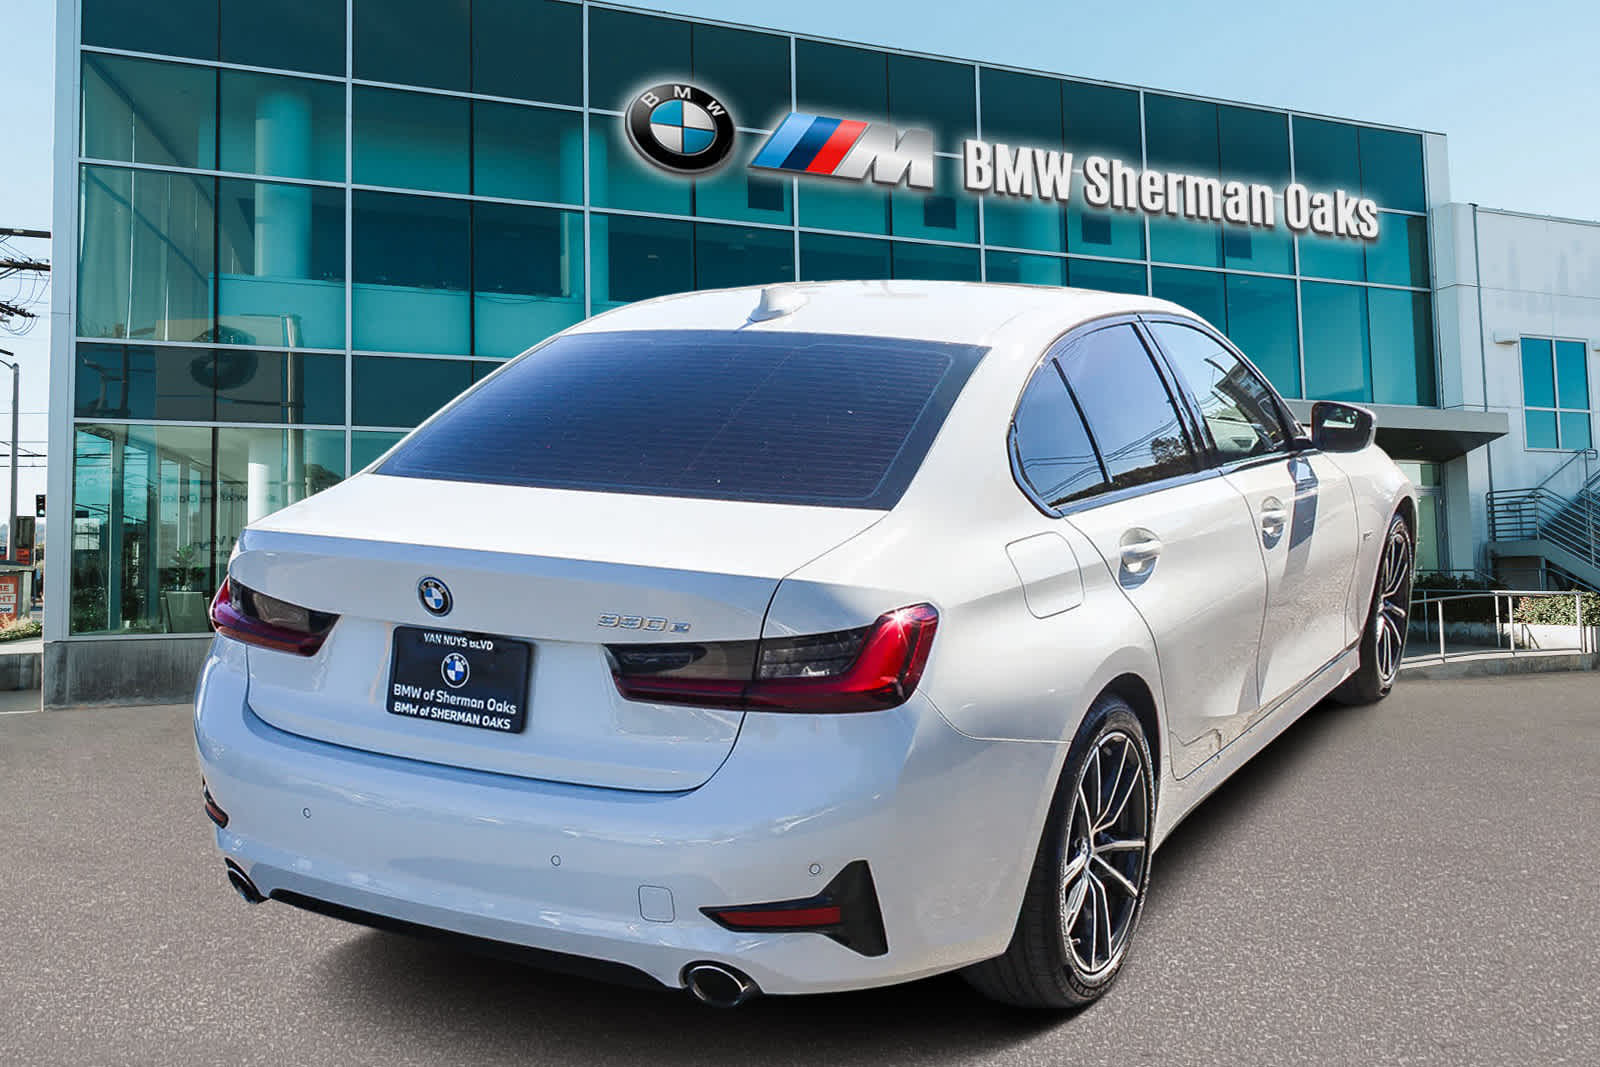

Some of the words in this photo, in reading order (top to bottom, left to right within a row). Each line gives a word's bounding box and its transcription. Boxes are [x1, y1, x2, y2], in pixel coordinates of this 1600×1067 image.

[641, 86, 725, 117] BMW
[962, 138, 1073, 202] BMW
[1083, 155, 1275, 227] Sherman
[1284, 183, 1380, 241] Oaks
[423, 633, 441, 644] VAN
[443, 634, 468, 648] NUYS
[469, 640, 494, 651] BLVD
[393, 683, 422, 700] BMW
[423, 688, 435, 701] of
[436, 690, 485, 710] Sherman
[487, 698, 517, 715] Oaks
[393, 701, 419, 716] BMW
[419, 705, 429, 717] of
[430, 706, 480, 726] SHERMAN
[482, 715, 511, 730] OAKS
